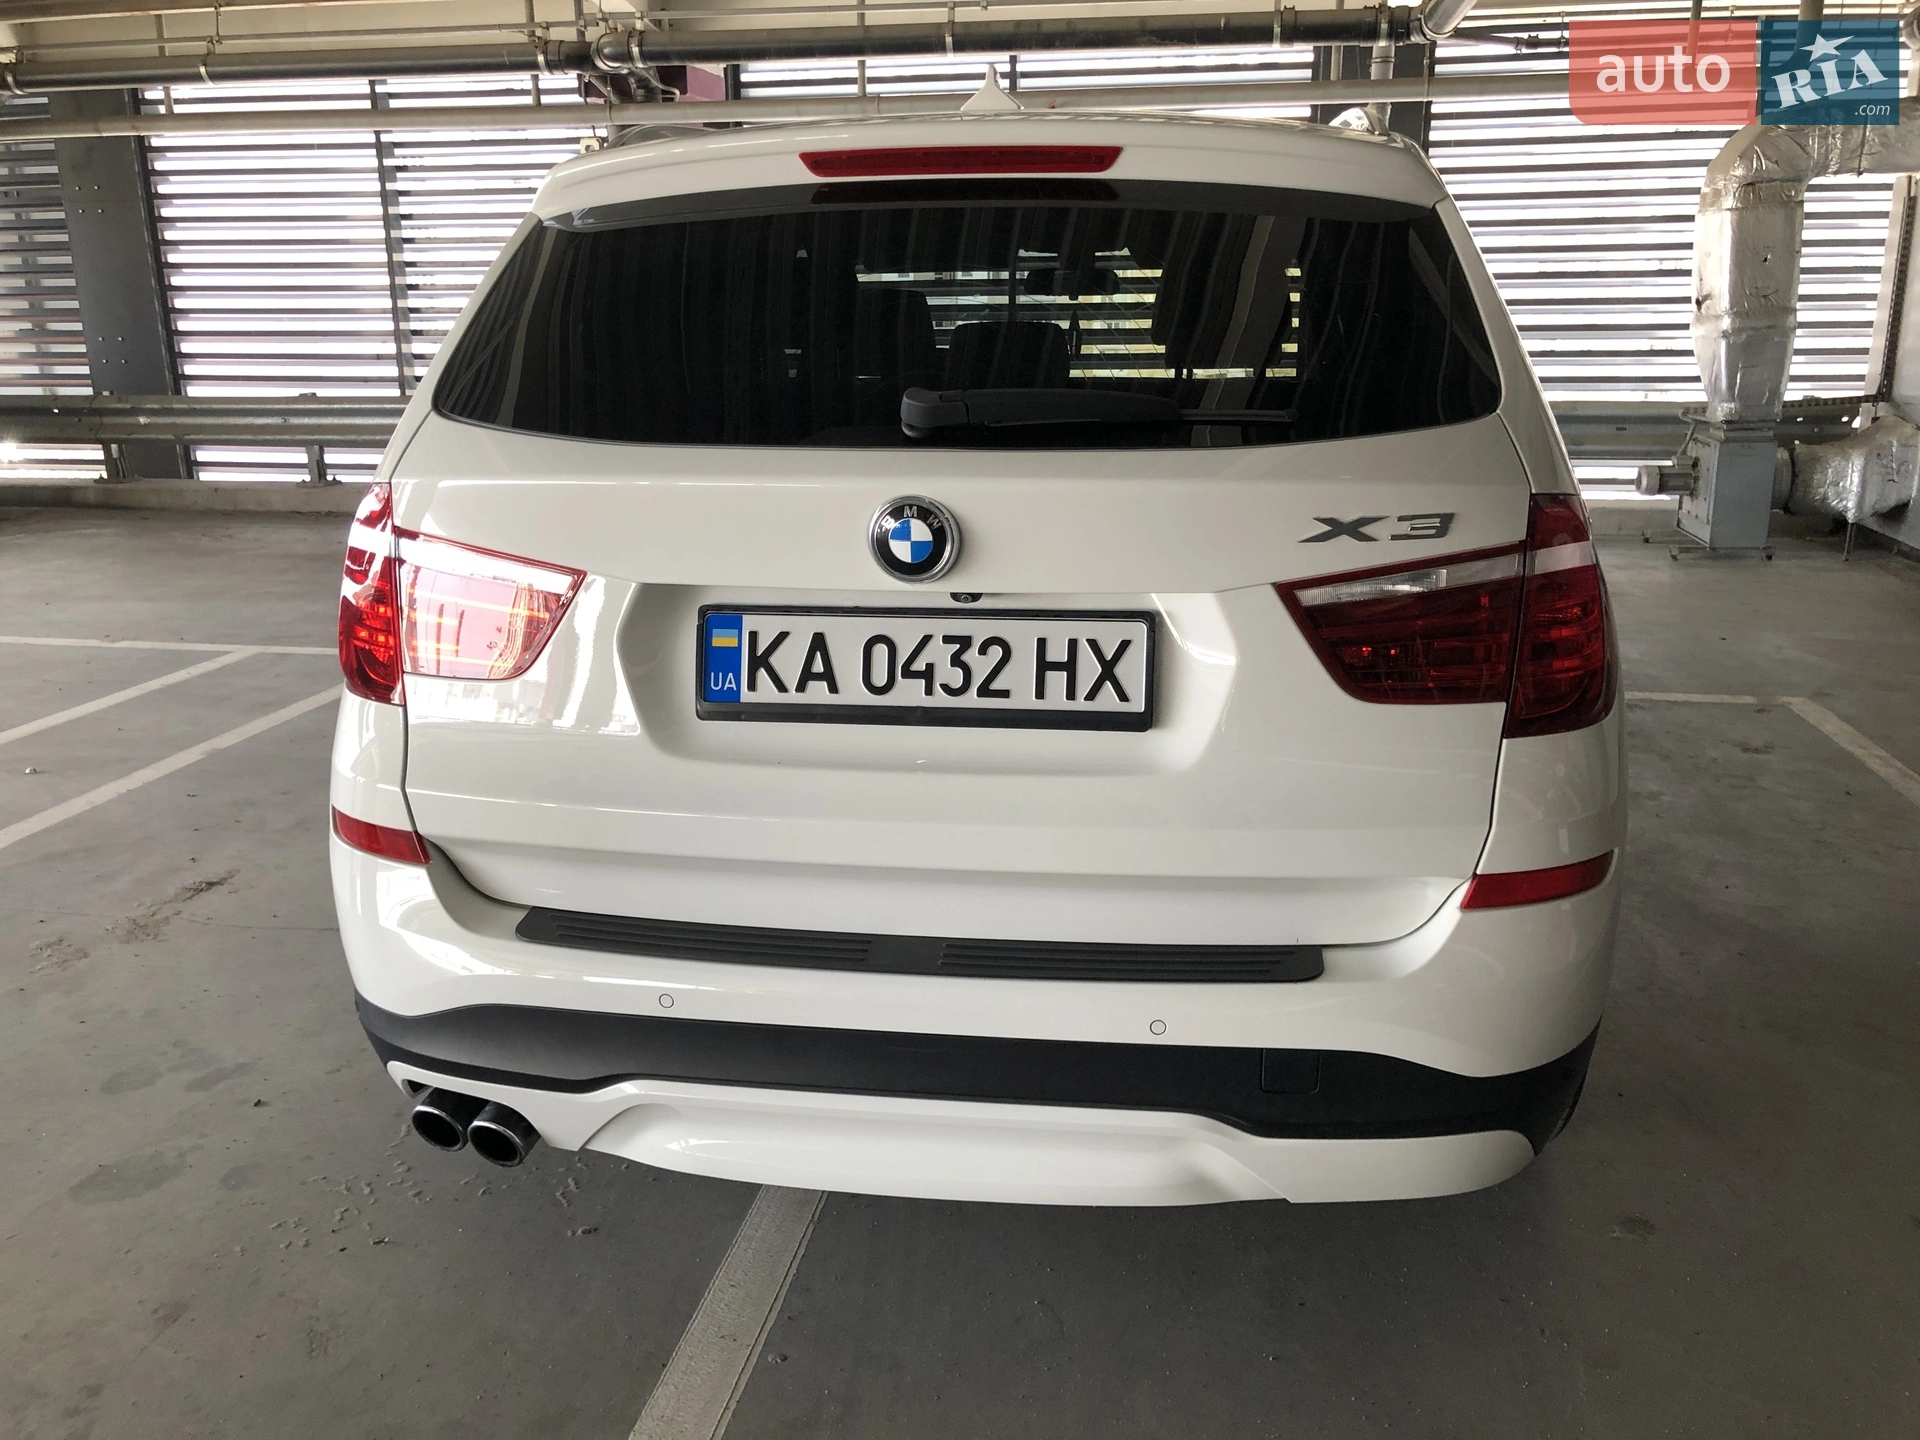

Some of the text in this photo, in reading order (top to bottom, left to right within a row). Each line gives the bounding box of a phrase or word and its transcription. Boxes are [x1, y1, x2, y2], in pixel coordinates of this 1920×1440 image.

[881, 505, 942, 530] BMW
[1298, 513, 1455, 543] X3
[746, 630, 1132, 702] KA 0432 HX
[710, 672, 737, 692] UA
